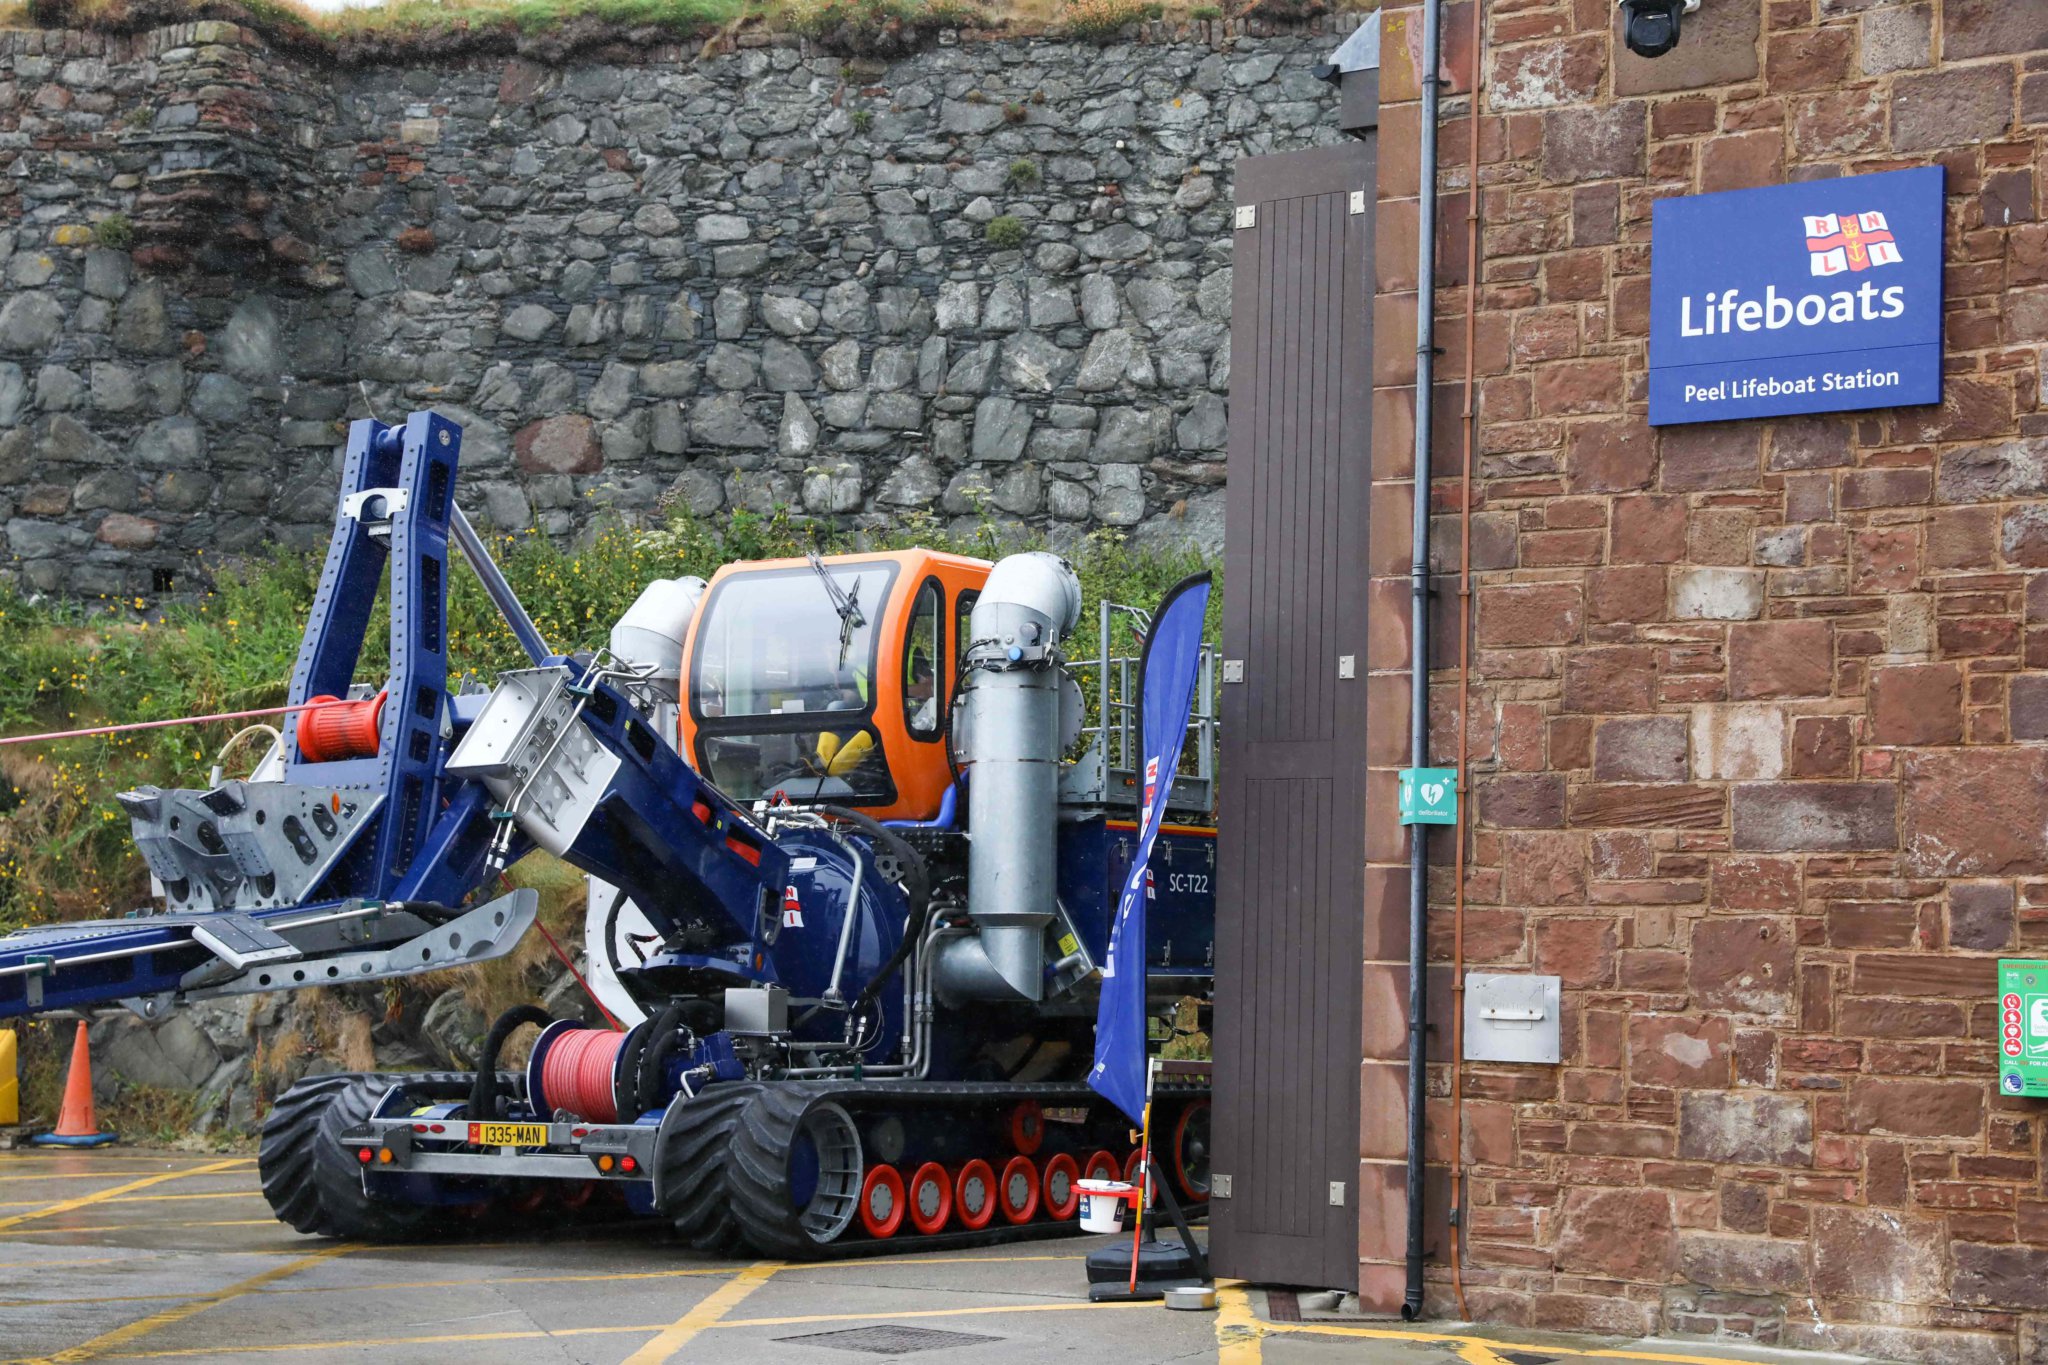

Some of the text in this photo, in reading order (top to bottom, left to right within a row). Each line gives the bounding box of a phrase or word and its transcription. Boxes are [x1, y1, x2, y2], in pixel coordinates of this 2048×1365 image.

[1681, 281, 1905, 337] Lifeboats
[1684, 368, 1899, 402] Peel Lifeboat Station
[1169, 873, 1209, 894] SC-T22
[486, 1127, 540, 1143] 1335-MAN
